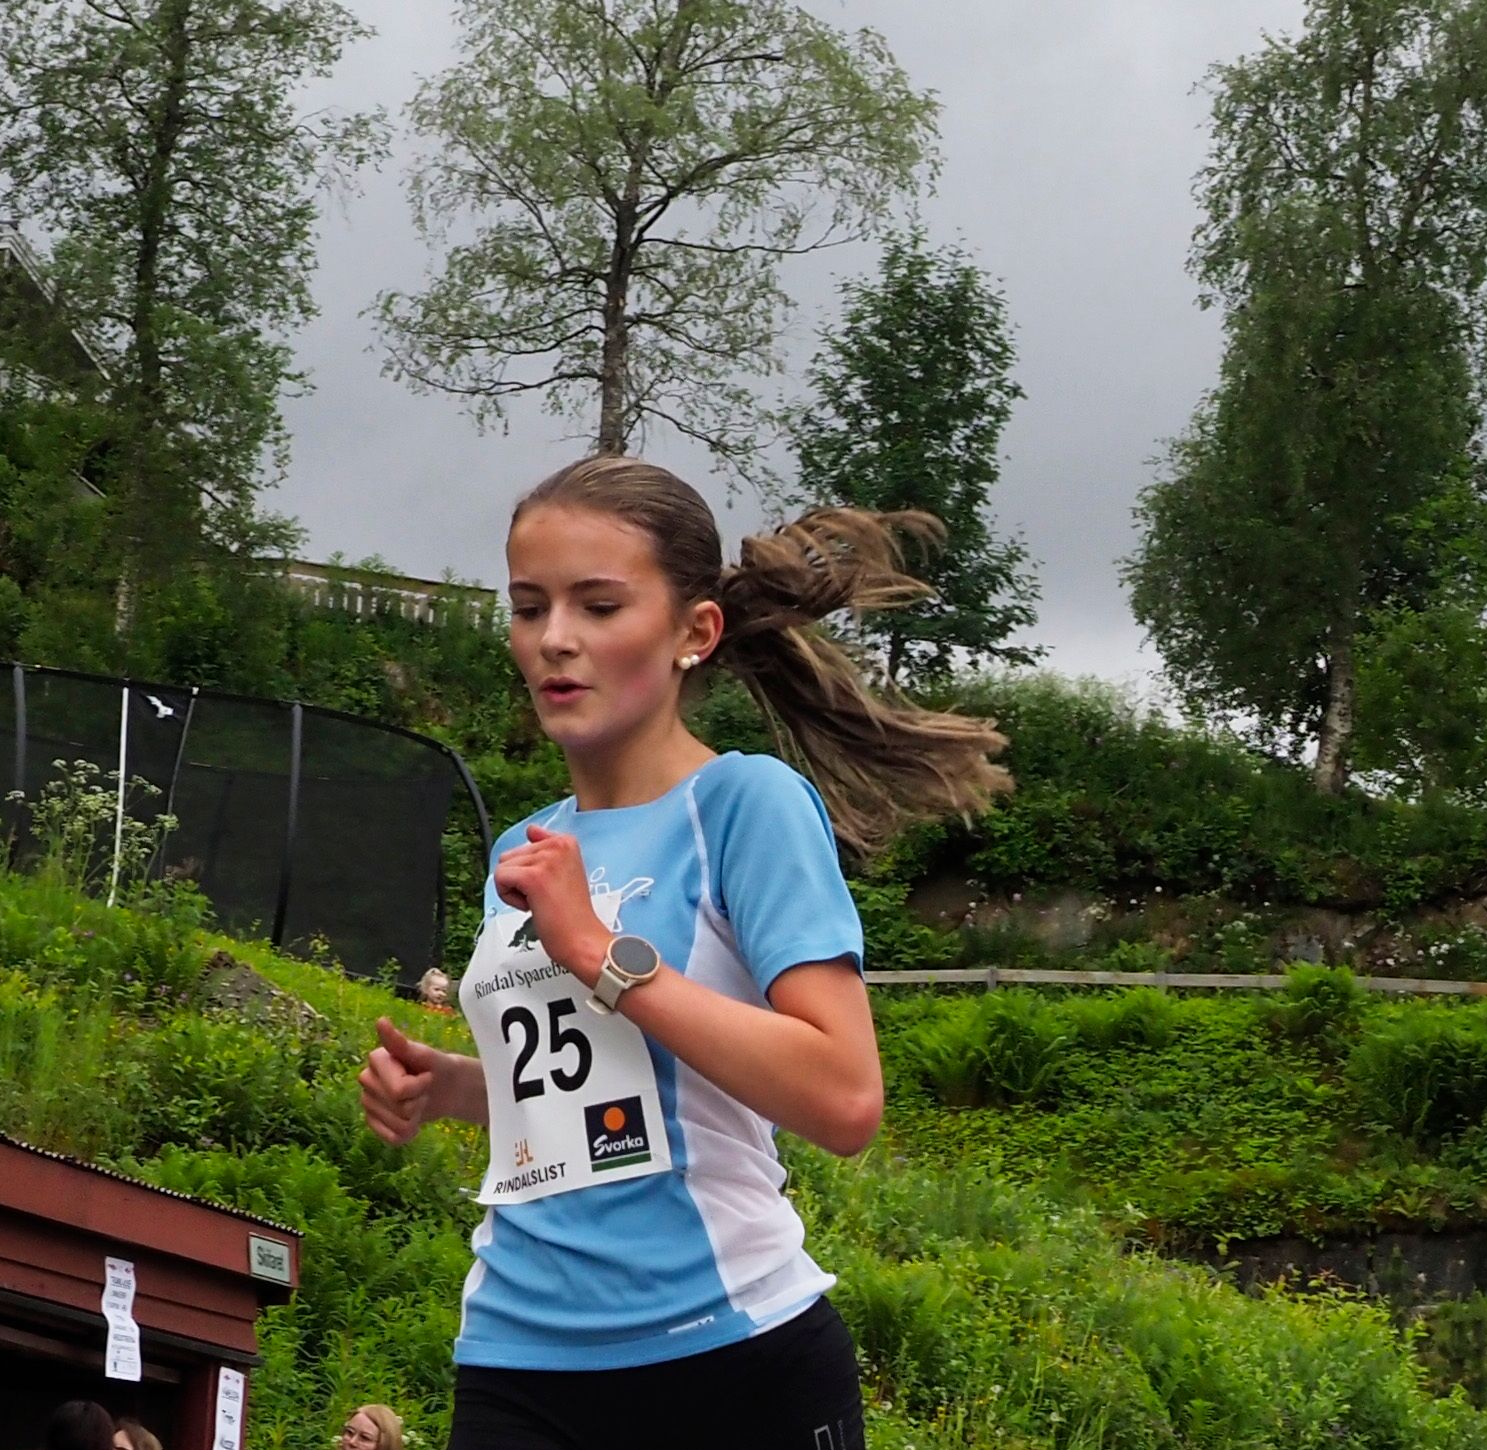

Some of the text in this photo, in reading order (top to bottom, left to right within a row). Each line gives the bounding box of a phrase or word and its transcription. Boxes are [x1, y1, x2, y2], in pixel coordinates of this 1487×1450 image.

[475, 971, 515, 999] Rindal
[501, 998, 592, 1103] 25
[593, 1134, 644, 1156] Svorka
[493, 1162, 566, 1194] RINDALSLIST
